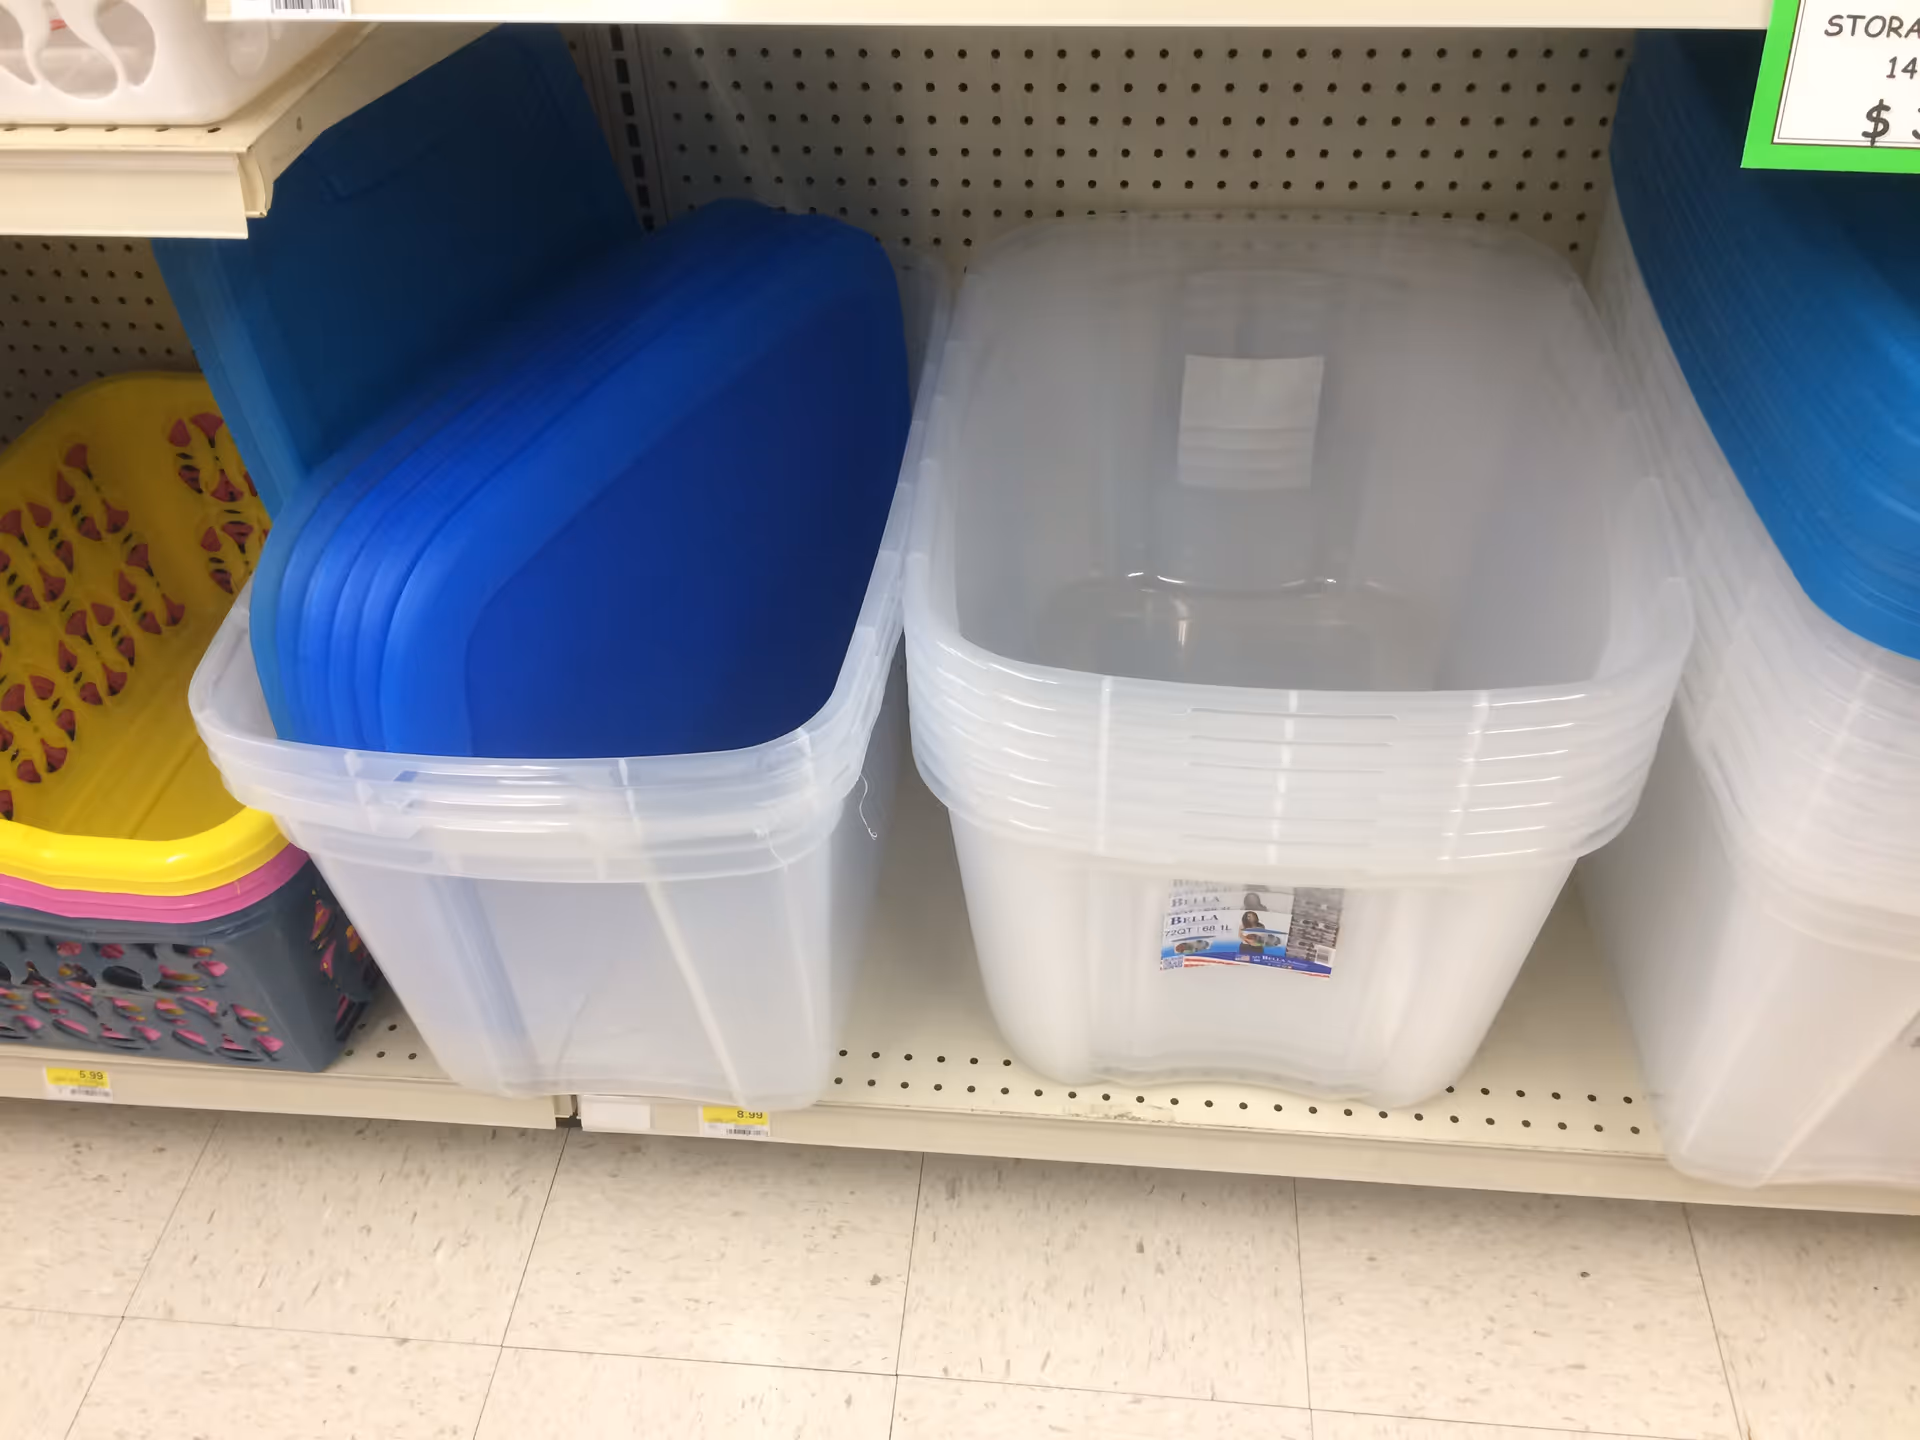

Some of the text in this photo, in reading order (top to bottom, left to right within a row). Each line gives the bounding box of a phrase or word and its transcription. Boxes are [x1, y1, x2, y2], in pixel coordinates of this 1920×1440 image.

[1886, 56, 1918, 80] 14
[1170, 914, 1219, 925] BELLA
[1163, 927, 1192, 937] 72QT
[79, 1070, 104, 1080] 5.99
